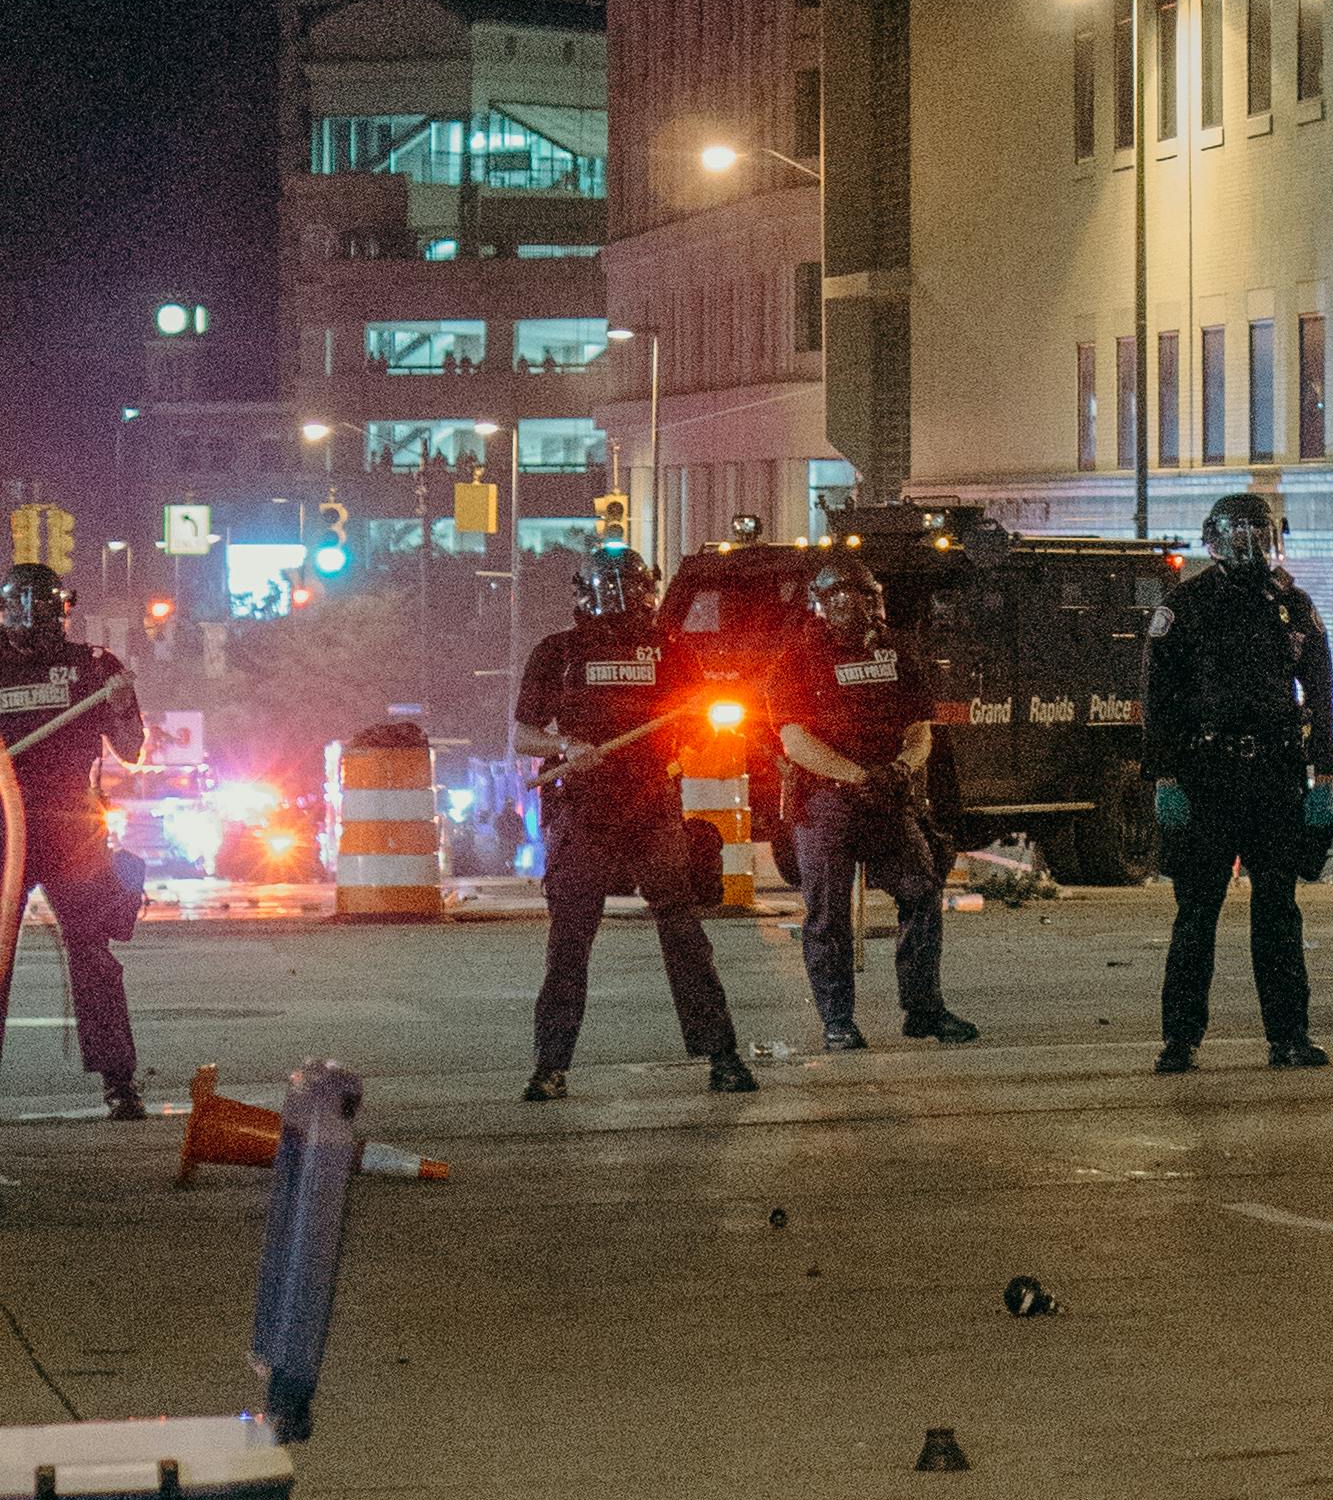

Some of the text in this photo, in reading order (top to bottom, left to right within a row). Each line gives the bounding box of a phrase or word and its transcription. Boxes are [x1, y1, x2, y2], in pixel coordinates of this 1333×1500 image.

[636, 646, 662, 661] 621
[588, 665, 653, 681] STATE POLICE
[969, 694, 1132, 727] Grand Rapids Police
